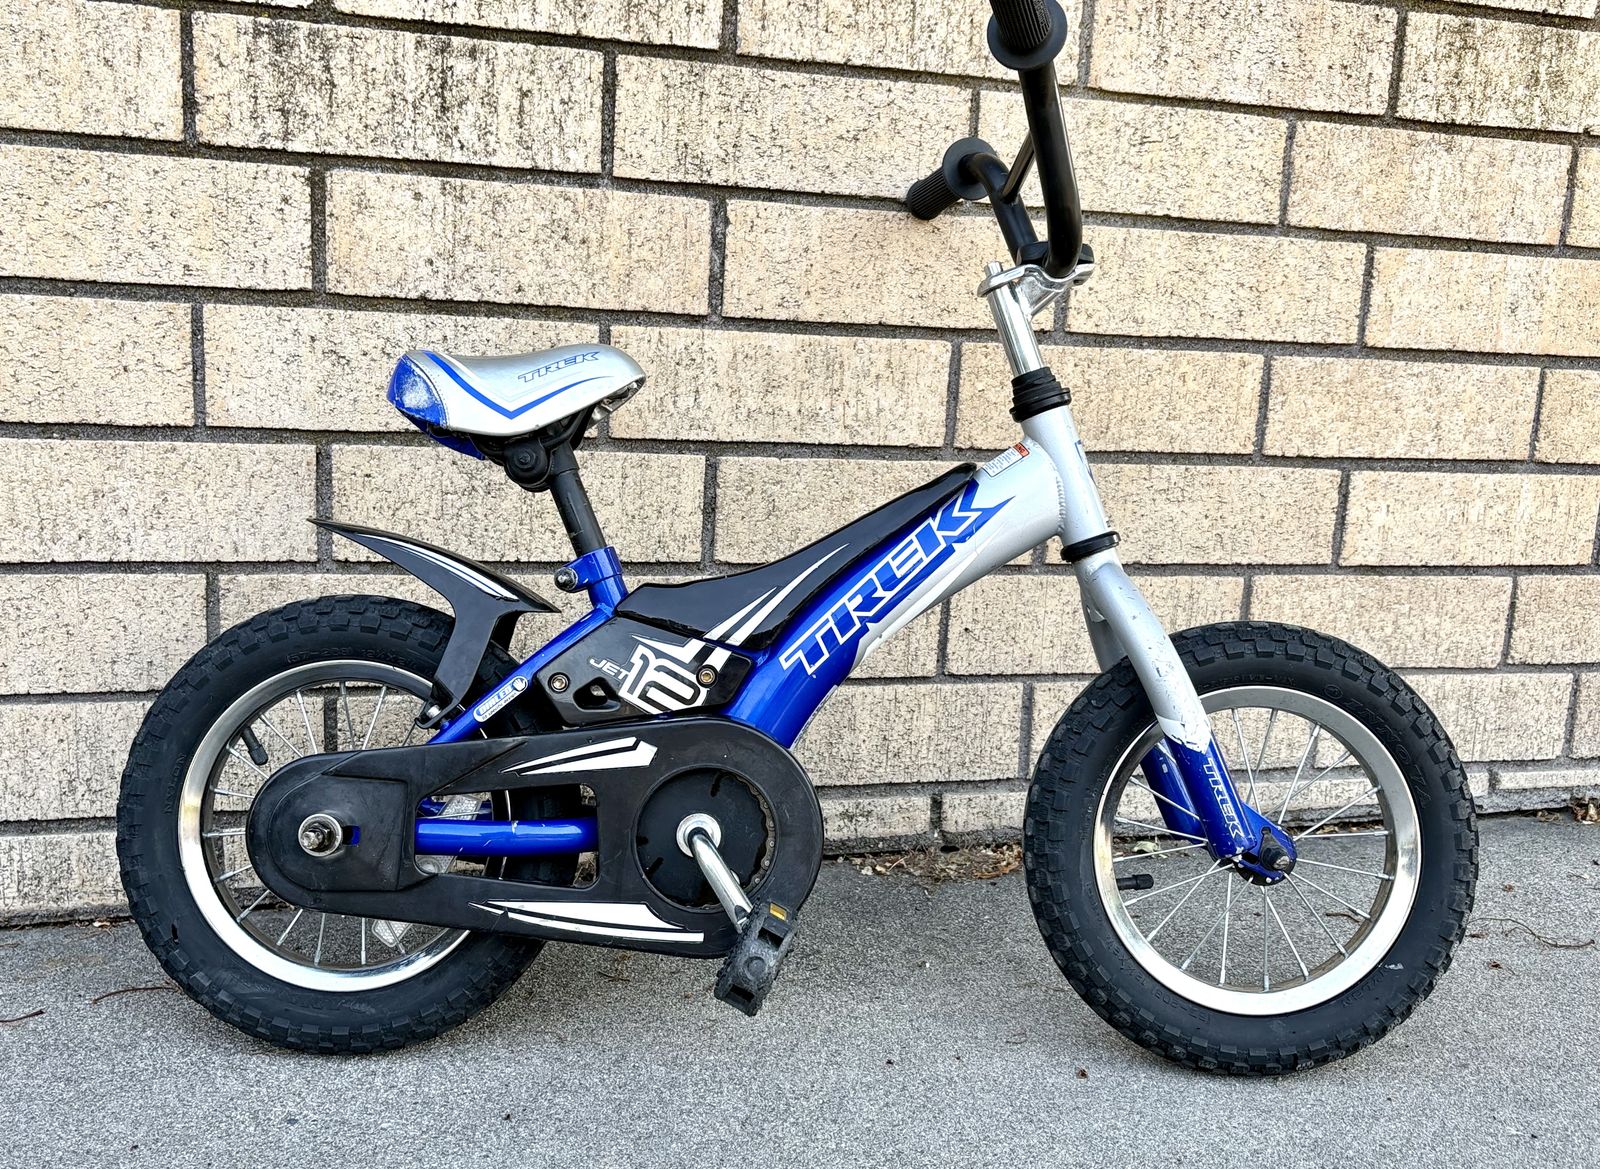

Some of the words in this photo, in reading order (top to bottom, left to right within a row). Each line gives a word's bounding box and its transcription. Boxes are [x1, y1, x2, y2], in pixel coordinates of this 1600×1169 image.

[518, 351, 600, 383] TREK
[779, 484, 984, 676] TREK
[589, 658, 630, 681] JET
[1203, 757, 1246, 839] TREK
